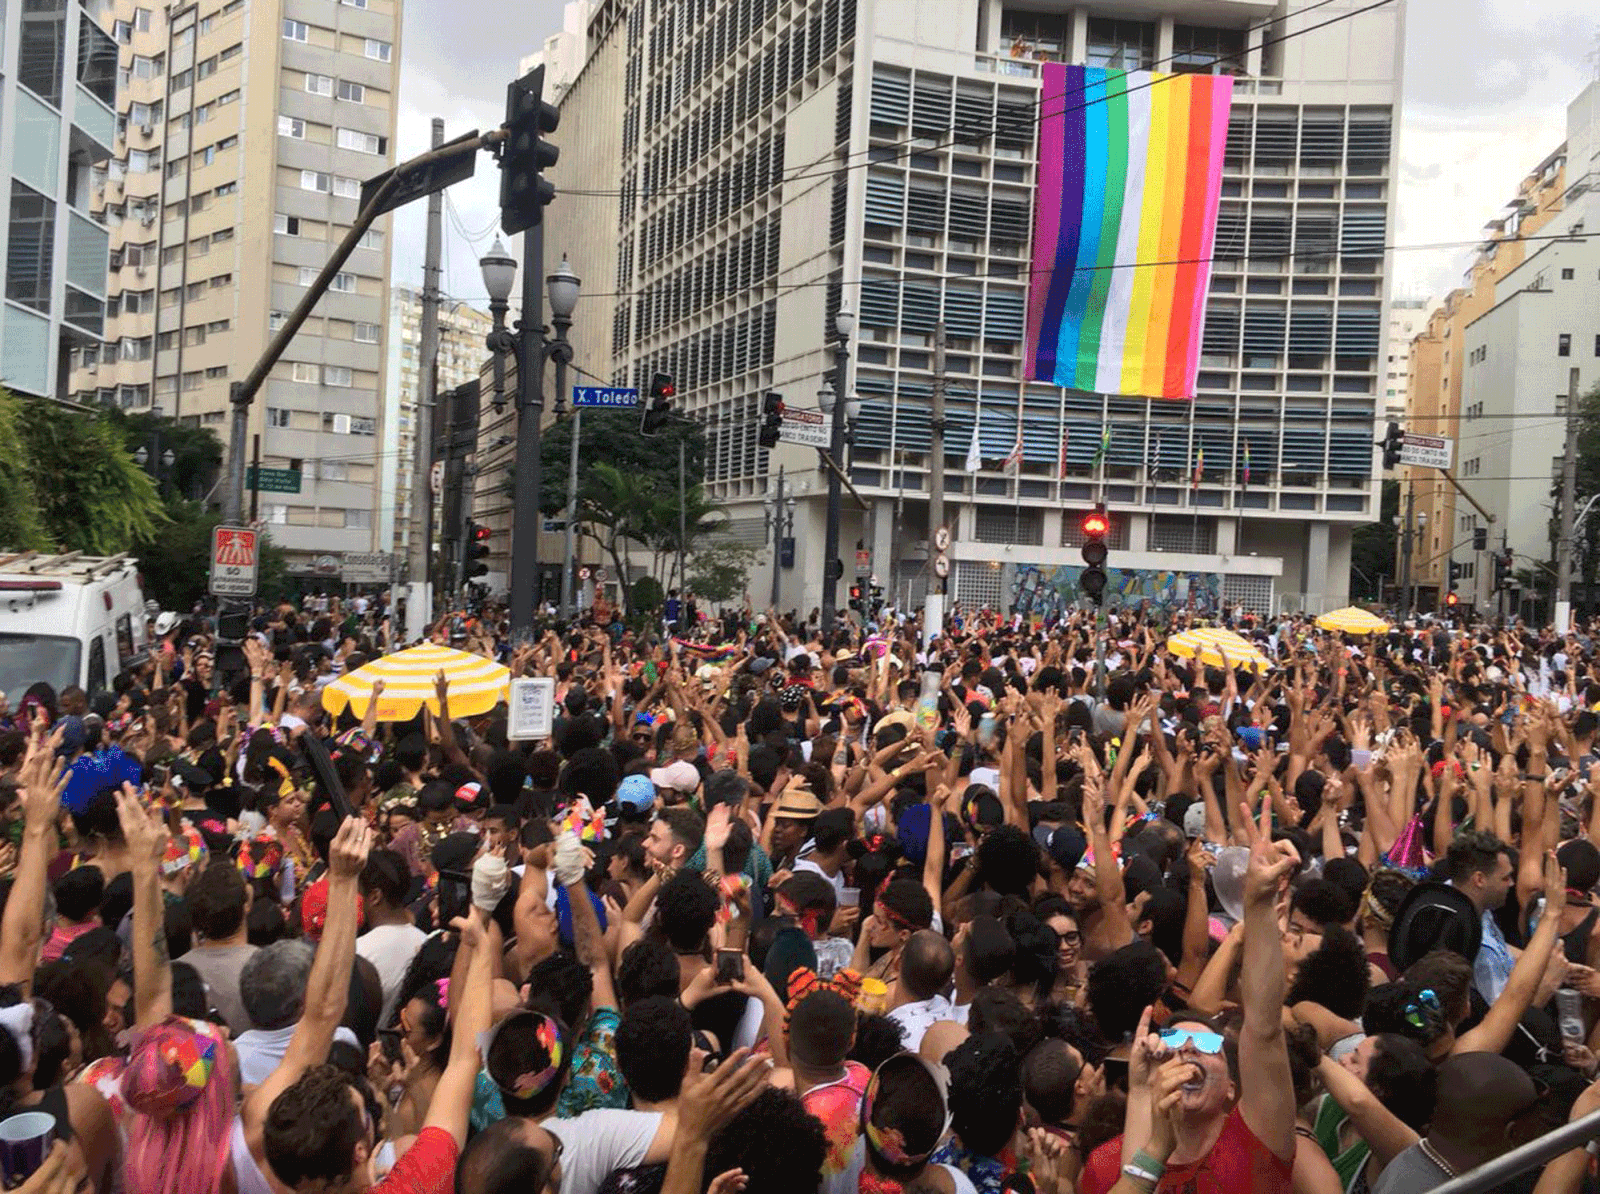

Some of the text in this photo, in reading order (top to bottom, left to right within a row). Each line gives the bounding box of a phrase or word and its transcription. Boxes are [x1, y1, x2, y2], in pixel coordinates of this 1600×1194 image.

[577, 389, 638, 405] X. Toledo
[780, 431, 796, 440] ANCO
